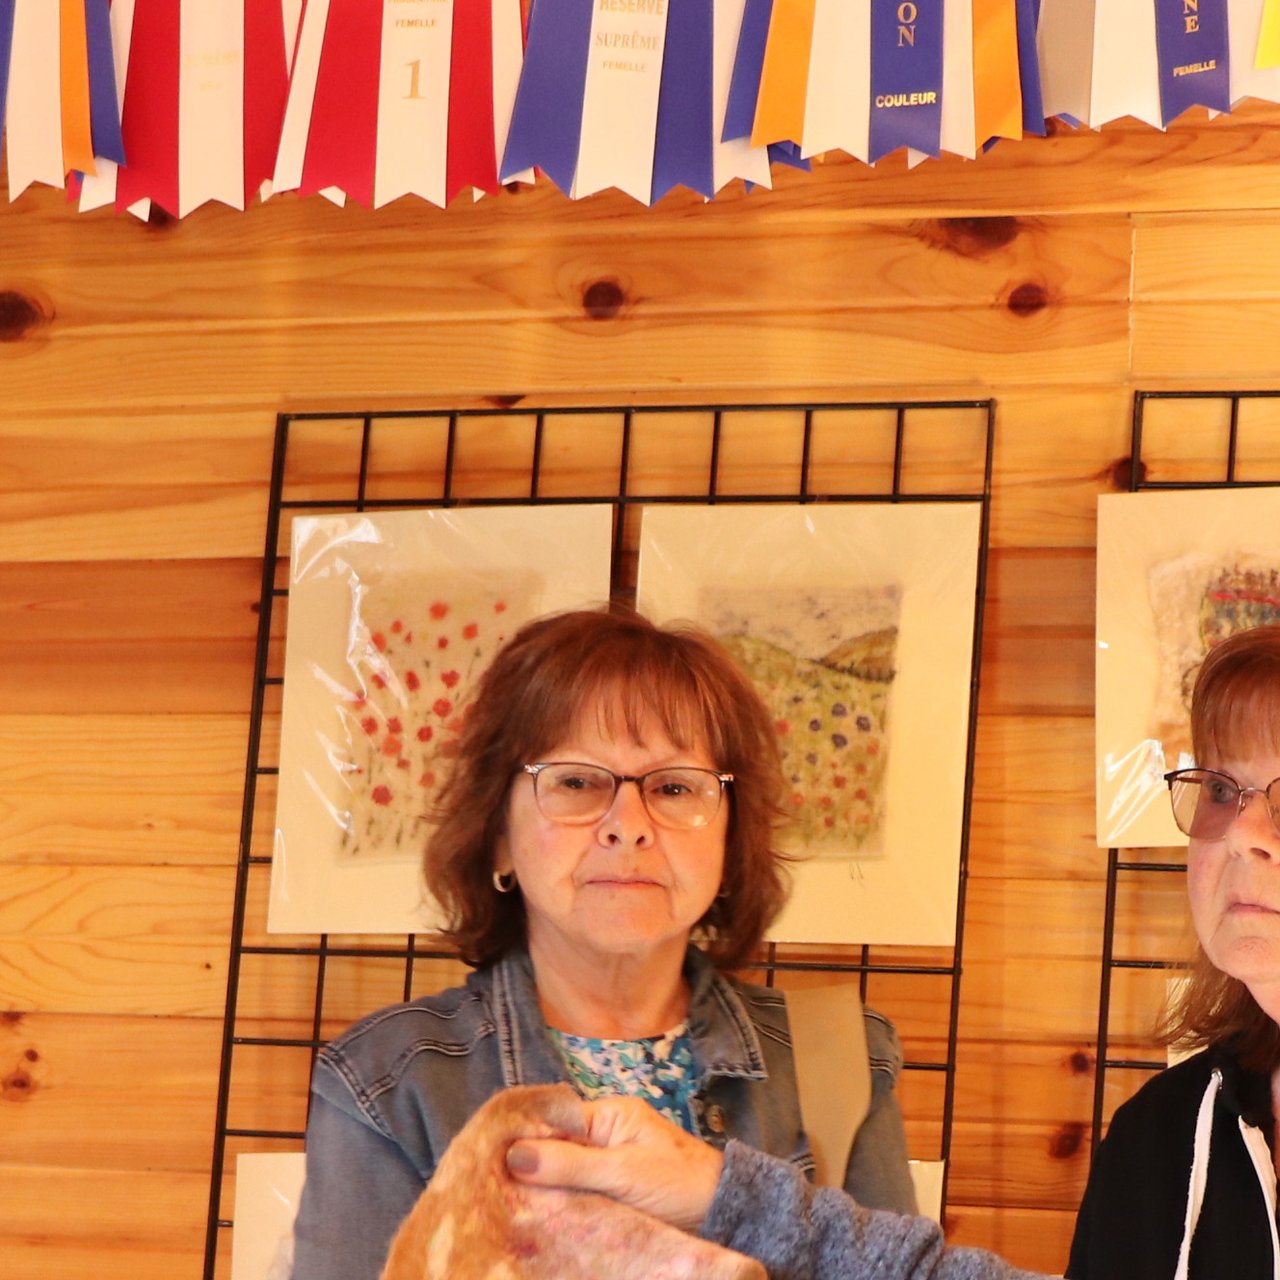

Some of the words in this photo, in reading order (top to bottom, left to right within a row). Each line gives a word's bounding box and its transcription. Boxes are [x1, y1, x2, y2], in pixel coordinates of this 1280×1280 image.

[395, 18, 438, 28] FEMELLE
[595, 30, 660, 51] SUPRÊME
[602, 60, 648, 73] FEMELLE
[1173, 59, 1217, 77] FEMELLE
[401, 59, 427, 100] 1
[875, 91, 937, 108] COULEUR
